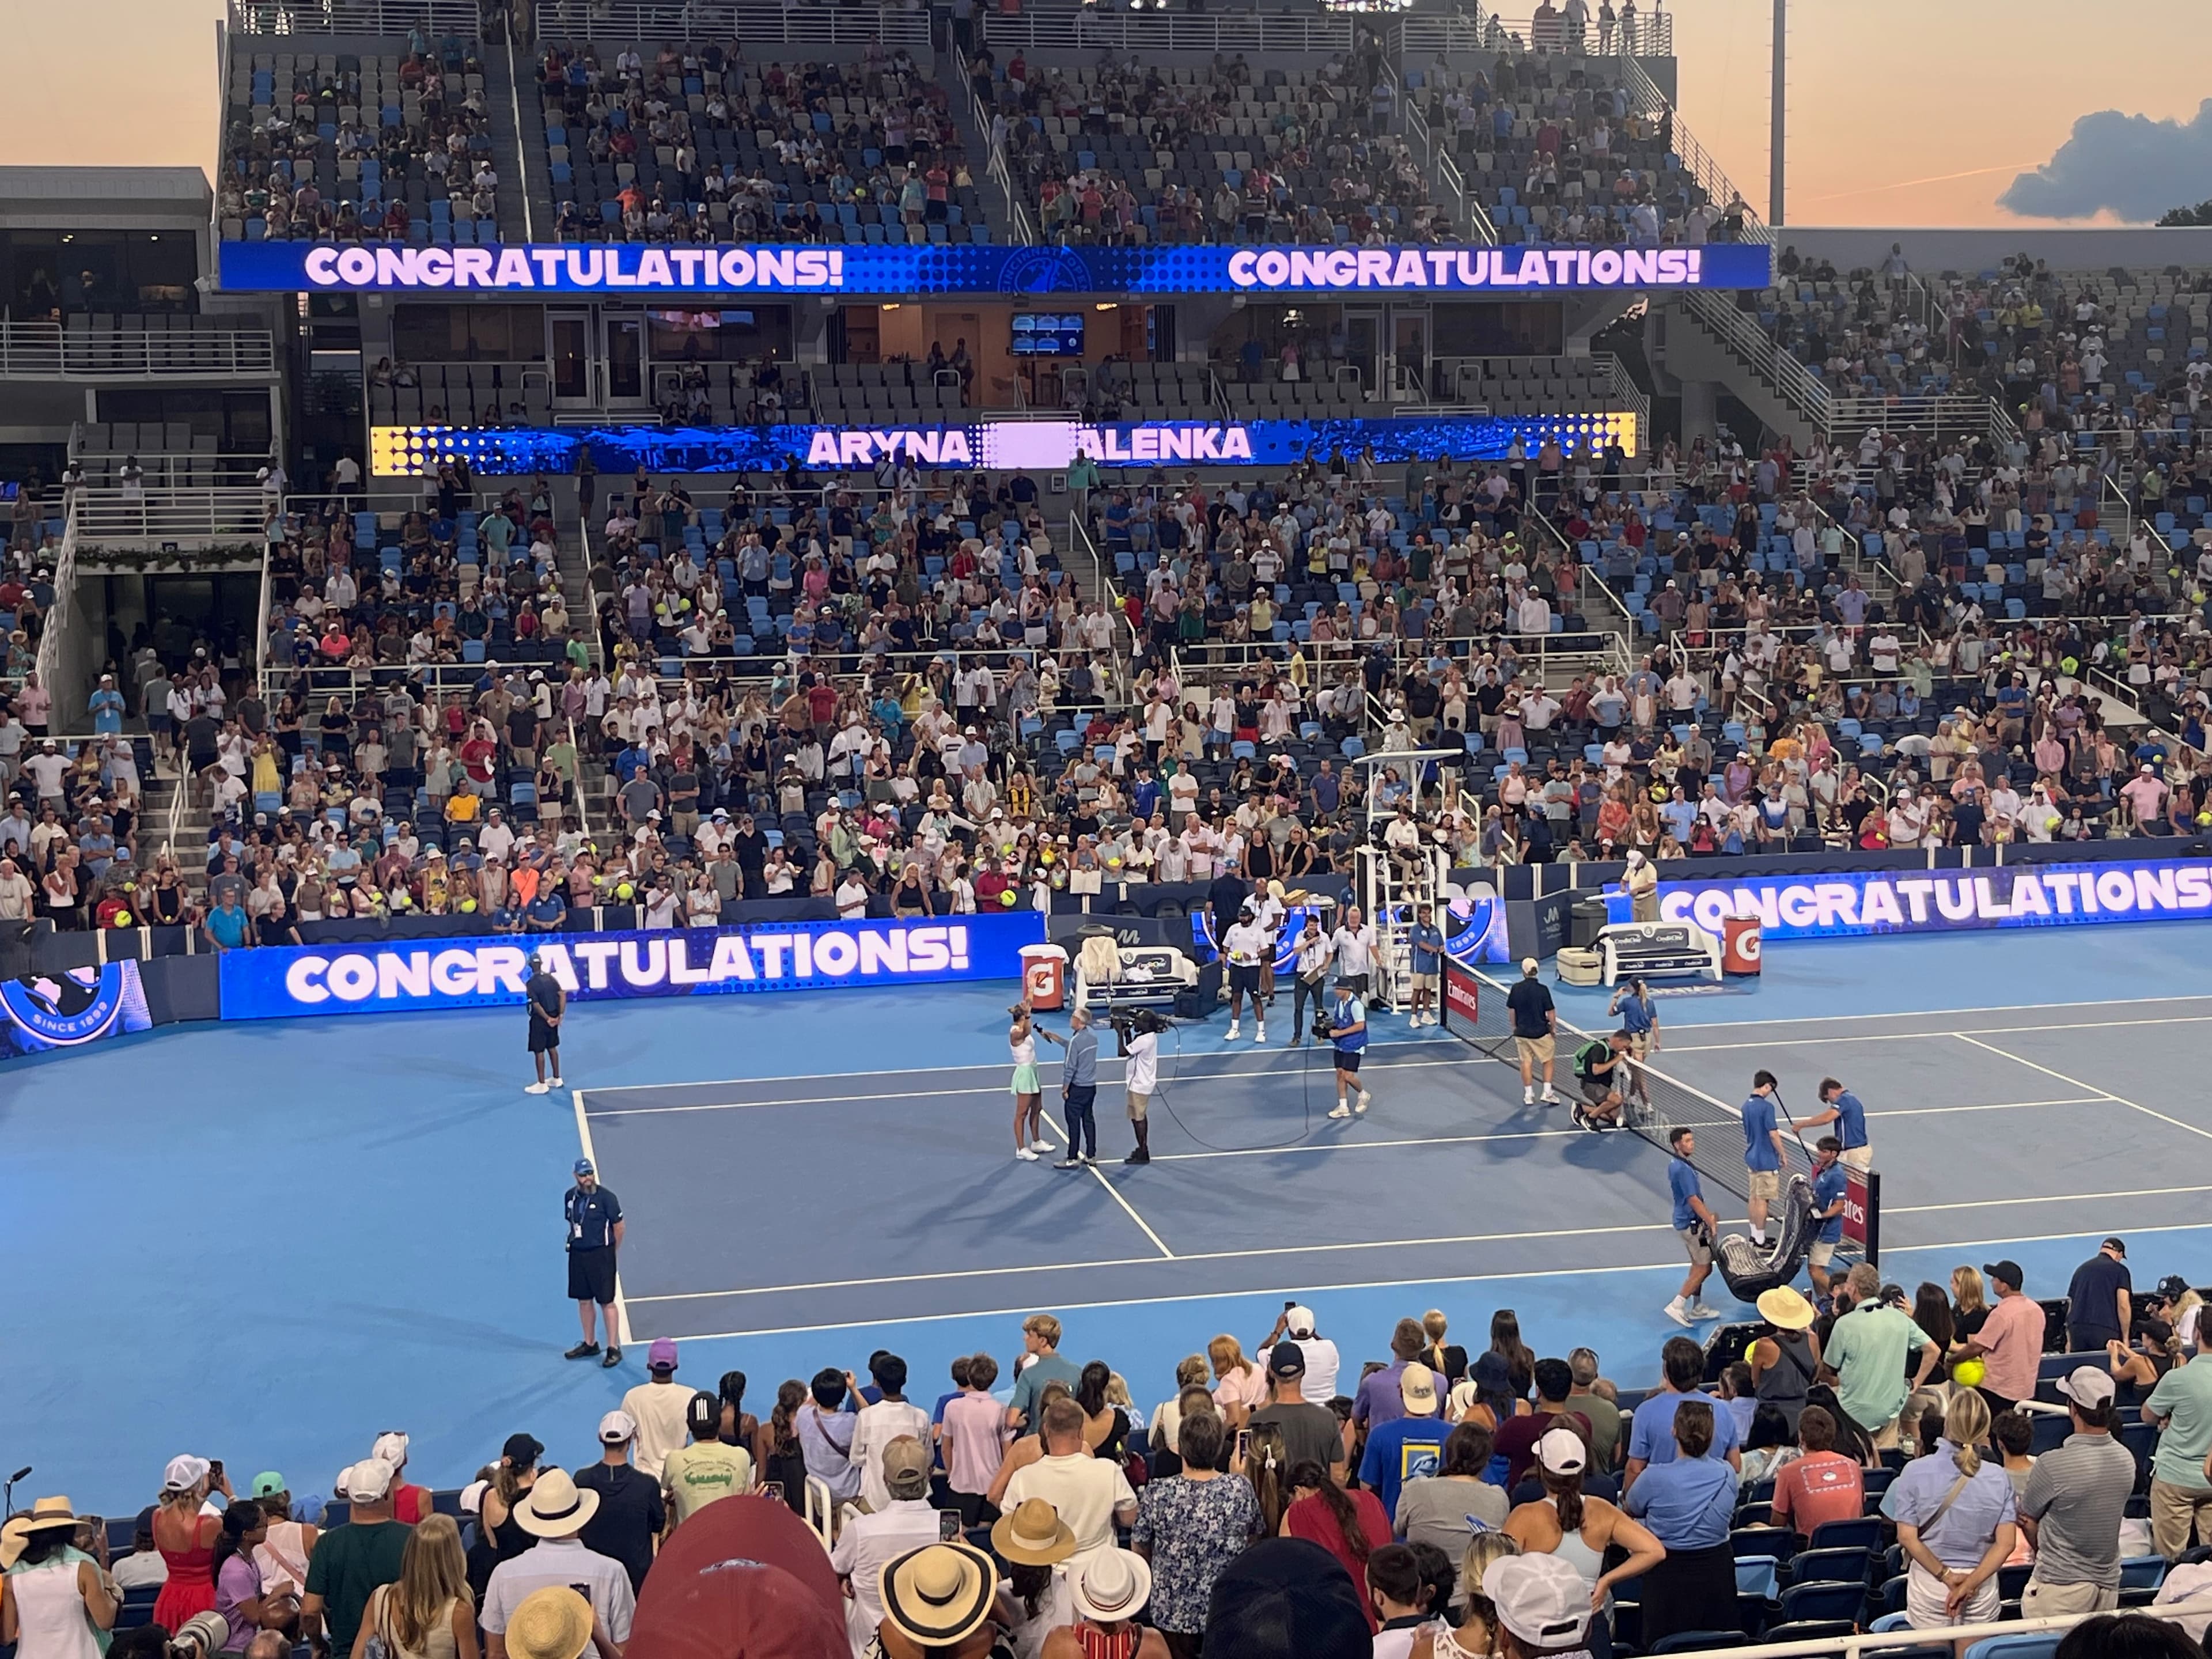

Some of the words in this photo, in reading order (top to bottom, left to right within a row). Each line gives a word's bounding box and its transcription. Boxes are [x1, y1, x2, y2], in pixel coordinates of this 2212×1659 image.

[305, 247, 843, 286] CONGRATULATIONS!
[1228, 249, 1701, 286] CONGRATULATIONS!
[807, 430, 971, 464] ARYNA
[1660, 866, 2212, 932] CONGRATULATIONS
[1736, 927, 1760, 961] G
[286, 926, 969, 1003] CONGRATULATIONS!
[1447, 979, 1476, 1010] Emirates
[32, 1013, 77, 1032] SINCE
[79, 1001, 107, 1028] 1899
